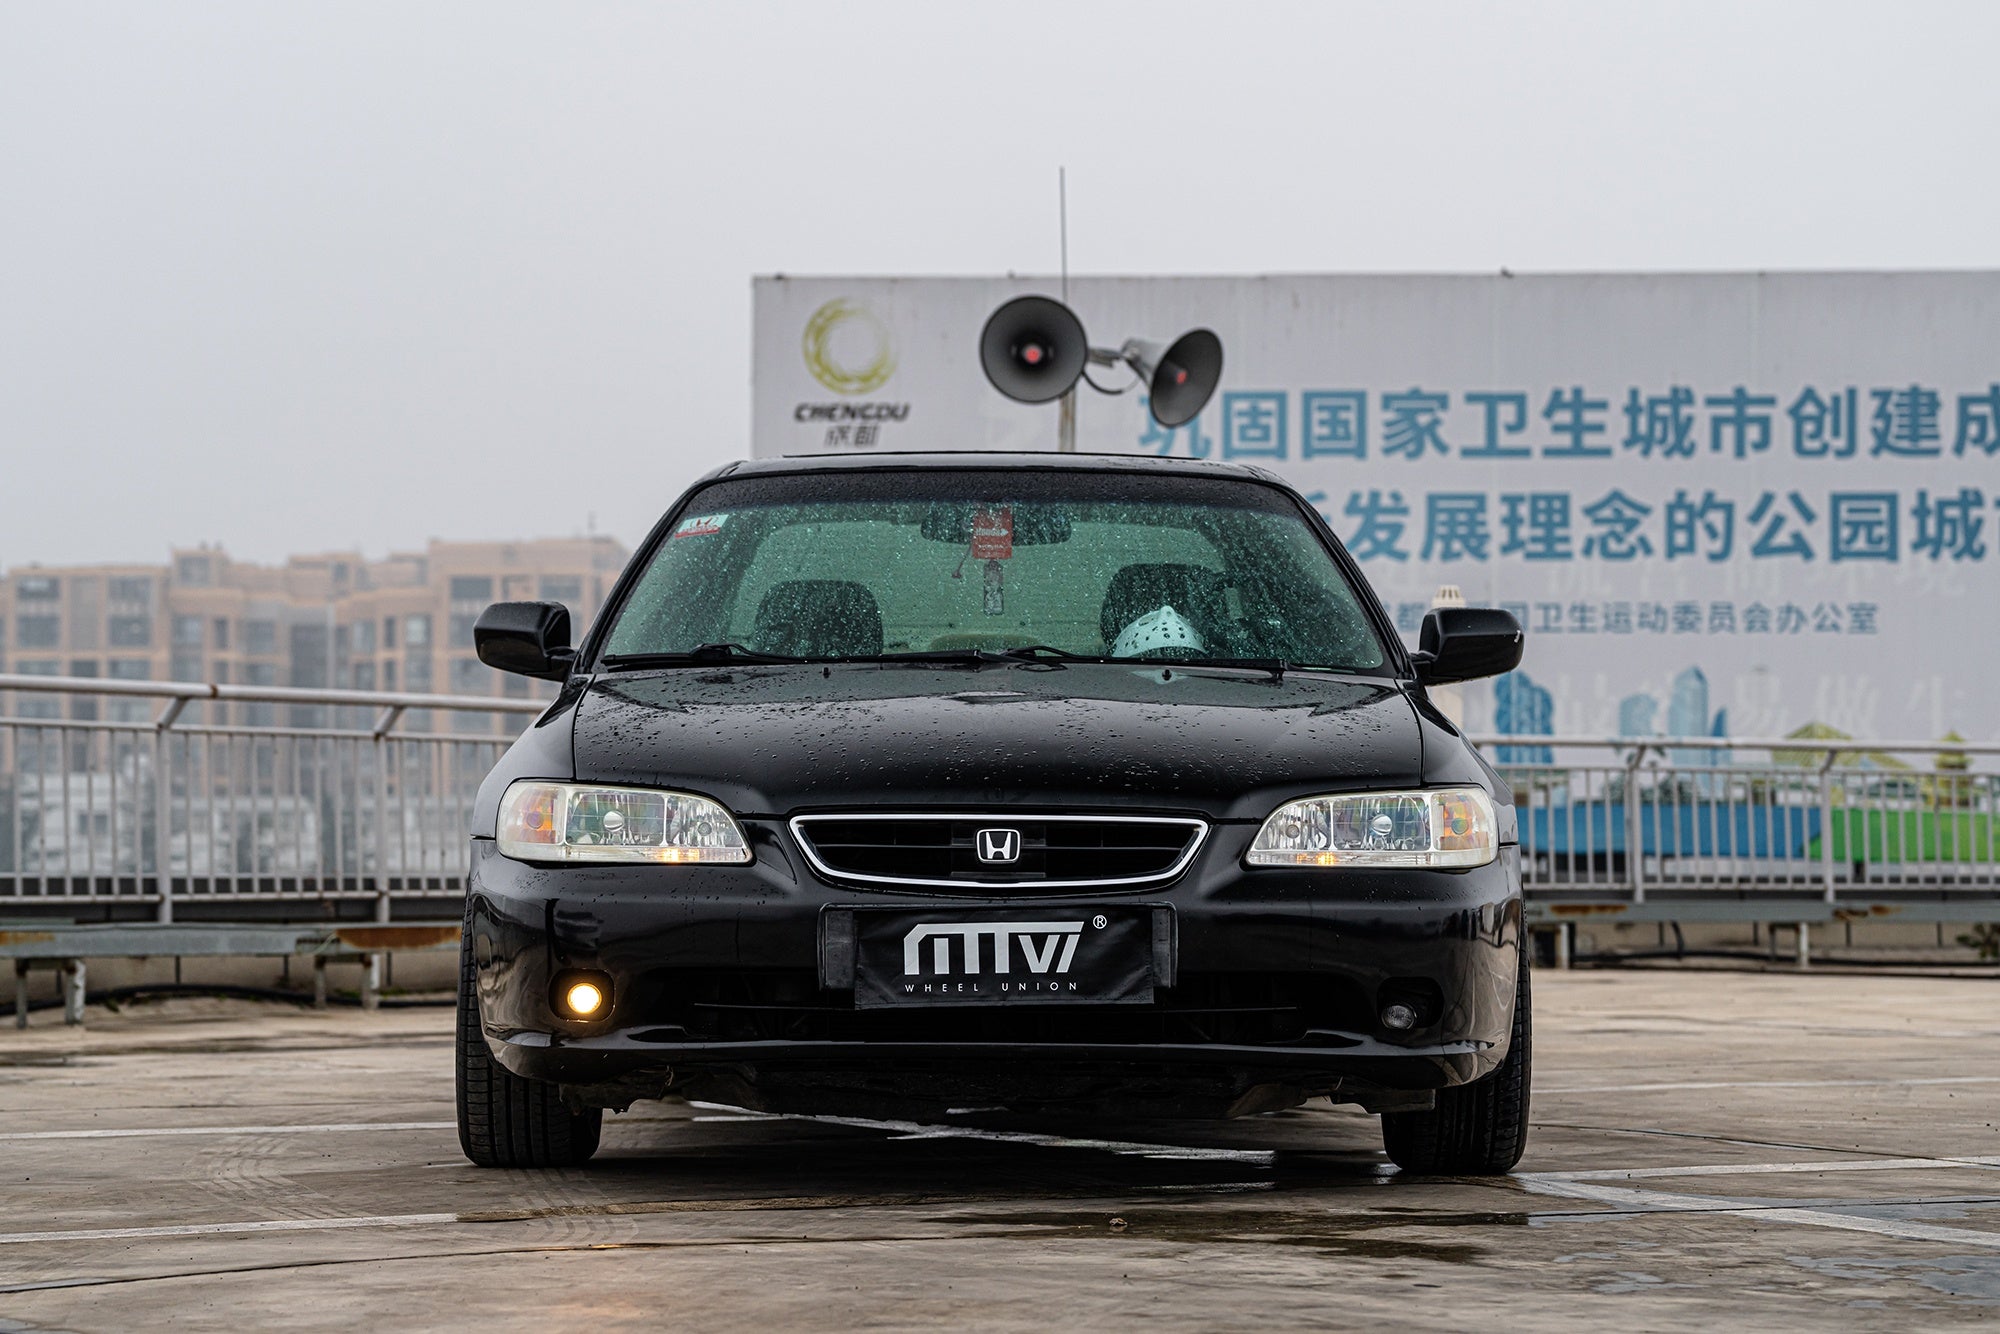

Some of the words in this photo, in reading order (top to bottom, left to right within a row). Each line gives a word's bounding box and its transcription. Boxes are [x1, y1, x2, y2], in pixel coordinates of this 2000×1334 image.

[1304, 487, 2000, 563] 发展理念的公园城
[905, 983, 979, 993] WHEEL
[1001, 982, 1077, 991] UNION
